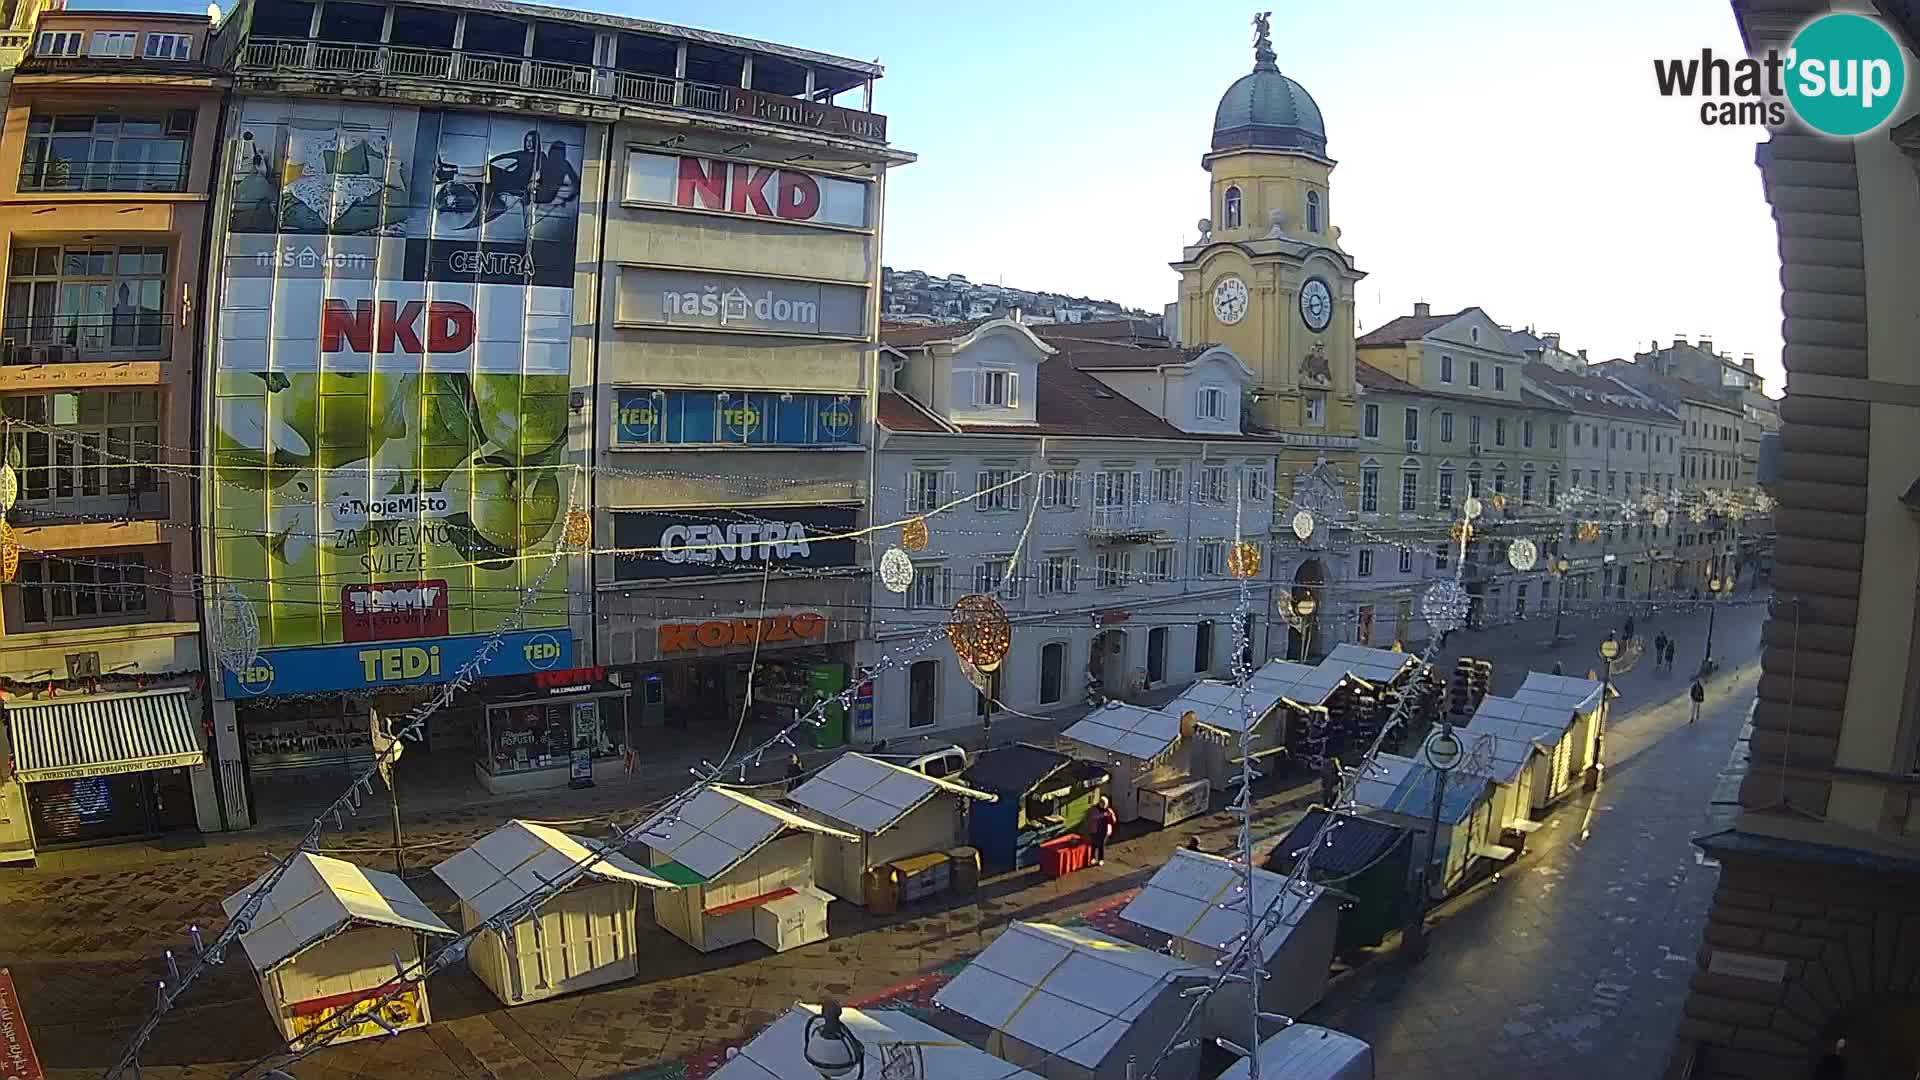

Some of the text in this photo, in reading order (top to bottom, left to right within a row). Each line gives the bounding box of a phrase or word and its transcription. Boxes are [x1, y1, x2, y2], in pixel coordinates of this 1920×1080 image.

[676, 156, 821, 221] NKD
[256, 244, 367, 269] naš dom
[449, 249, 536, 277] CENTRA
[662, 284, 817, 323] naš dom
[321, 298, 477, 354] NKD
[619, 408, 658, 426] TEDi
[724, 409, 760, 427] TEDi
[338, 497, 448, 517] #TvojeMisto
[335, 522, 451, 549] ZA DNEVNO
[659, 521, 810, 565] CENTRA
[360, 546, 427, 575] SVJEŽE
[350, 586, 441, 615] TOMMY
[359, 646, 441, 683] TEDi
[523, 642, 561, 661] TEDi
[87, 761, 144, 776] INFORMATIVNI
[145, 758, 178, 769] CENTAR
